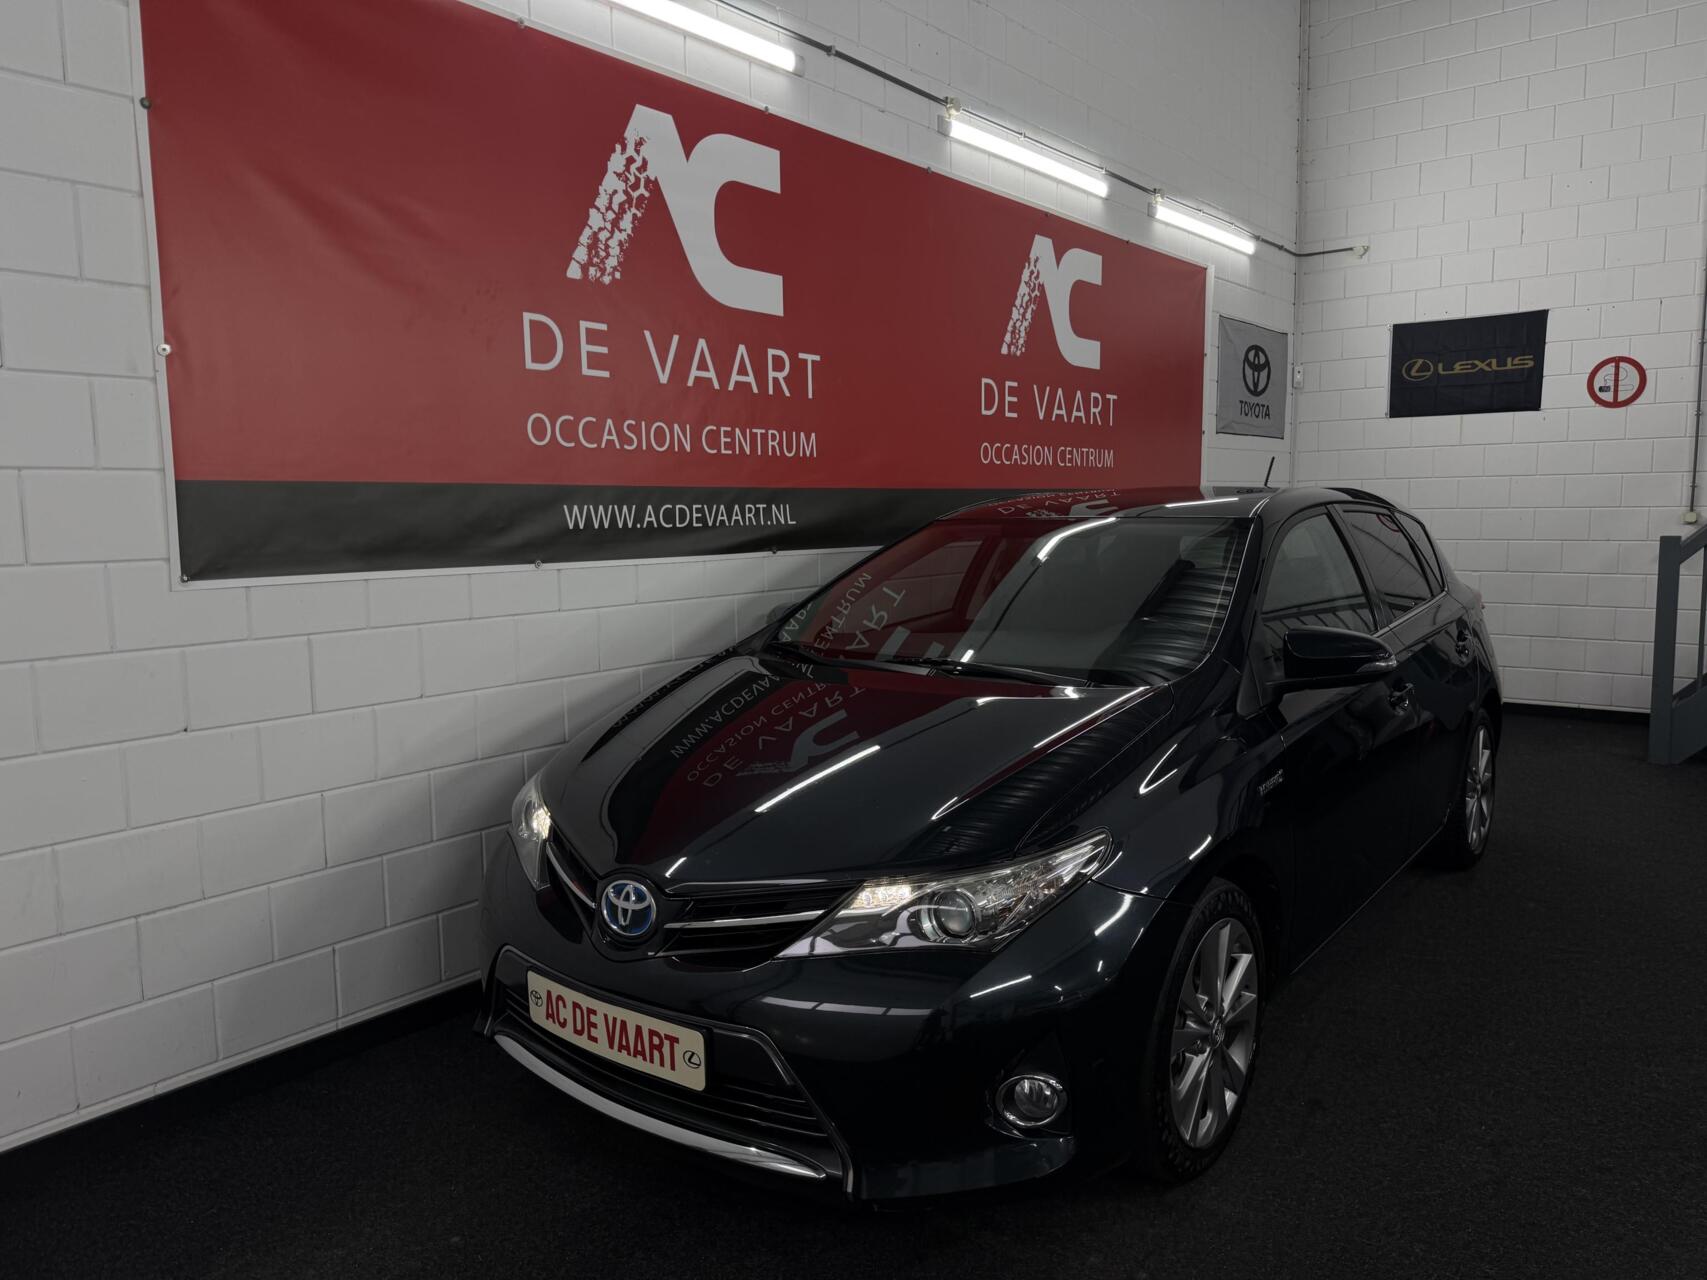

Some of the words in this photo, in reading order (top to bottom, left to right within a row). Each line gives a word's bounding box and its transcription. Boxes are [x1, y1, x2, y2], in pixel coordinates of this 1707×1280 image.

[566, 104, 784, 317] AC
[1001, 234, 1103, 370] AC
[522, 311, 611, 379] DE
[644, 329, 821, 400] VAART
[1437, 355, 1534, 375] LEXUS
[981, 378, 1018, 418] DE
[1033, 384, 1118, 427] VAART
[1239, 400, 1271, 420] TOYOTA
[526, 412, 692, 453] OCCASION
[702, 425, 818, 458] CENTRUM
[980, 442, 1053, 466] OCCASION
[1057, 446, 1114, 468] CENTRUM
[563, 503, 797, 530] WWW.ACDEVAART.NL
[545, 989, 567, 1029] AC
[572, 1001, 599, 1044] DE
[603, 1013, 680, 1072] VAART
